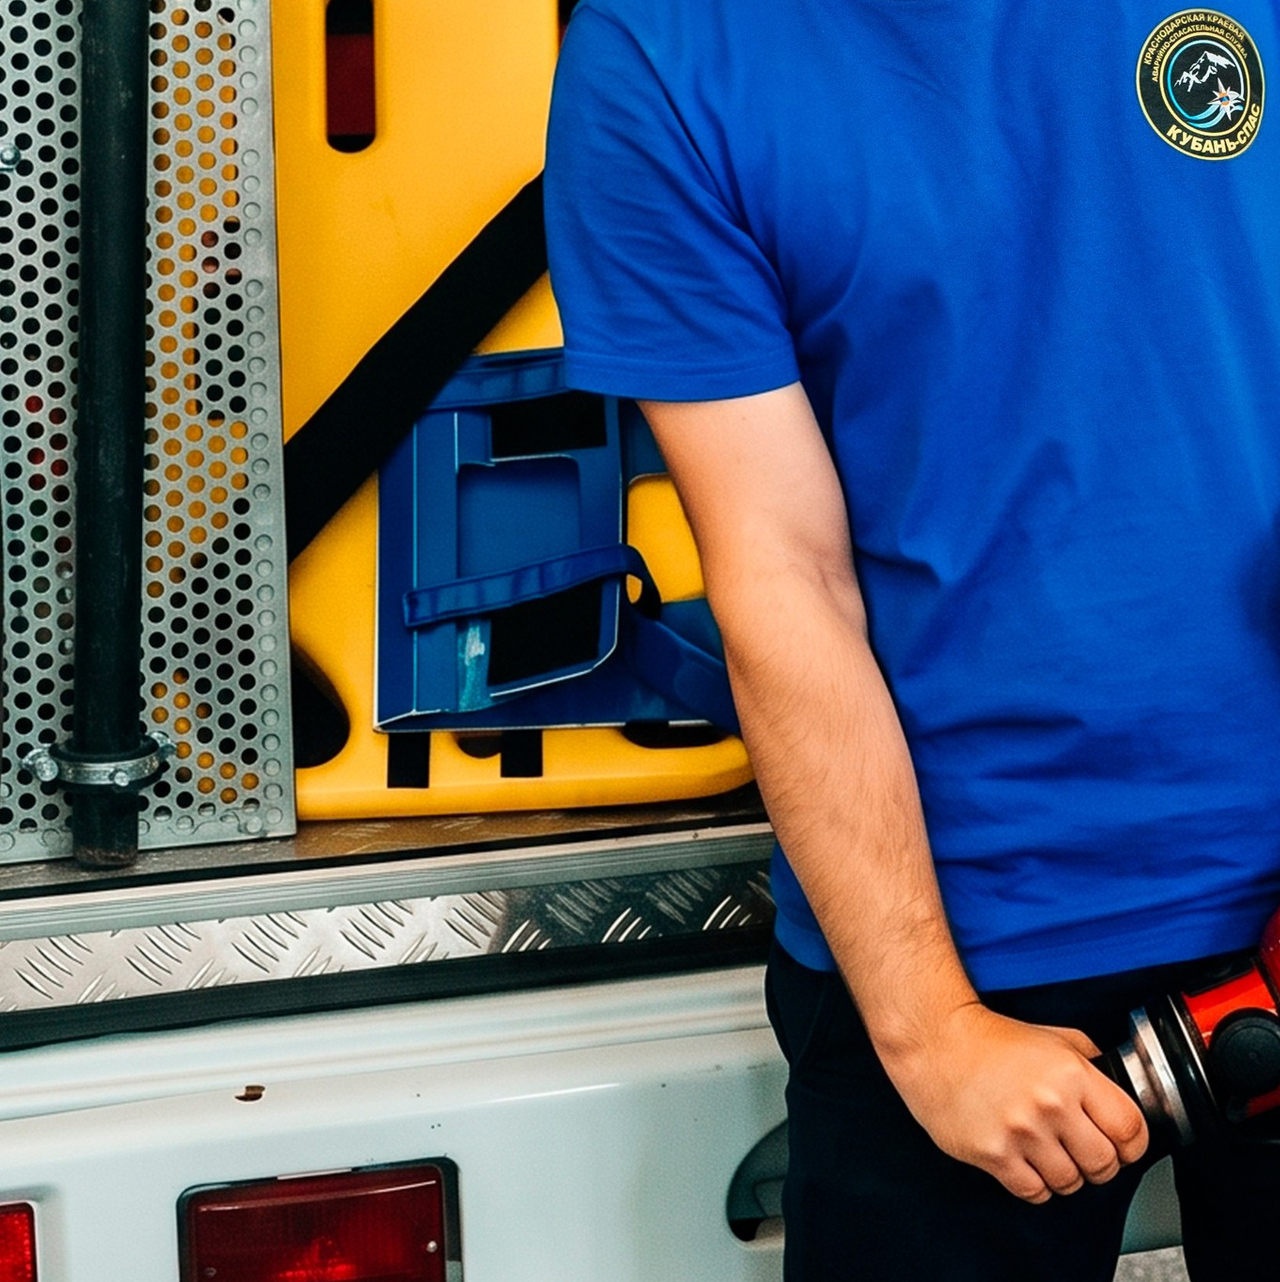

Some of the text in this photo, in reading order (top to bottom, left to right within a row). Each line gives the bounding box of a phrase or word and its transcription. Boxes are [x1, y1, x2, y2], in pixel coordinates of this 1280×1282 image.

[1144, 13, 1245, 65] КРАСНОДАРСКАЯ КРАЕВАЯ
[1152, 24, 1248, 82] АВАРИЙНО-СПАСАТЕЛЬНАЯ СЛУЖБА
[1166, 103, 1261, 154] КУБАНЬ-СПАС
